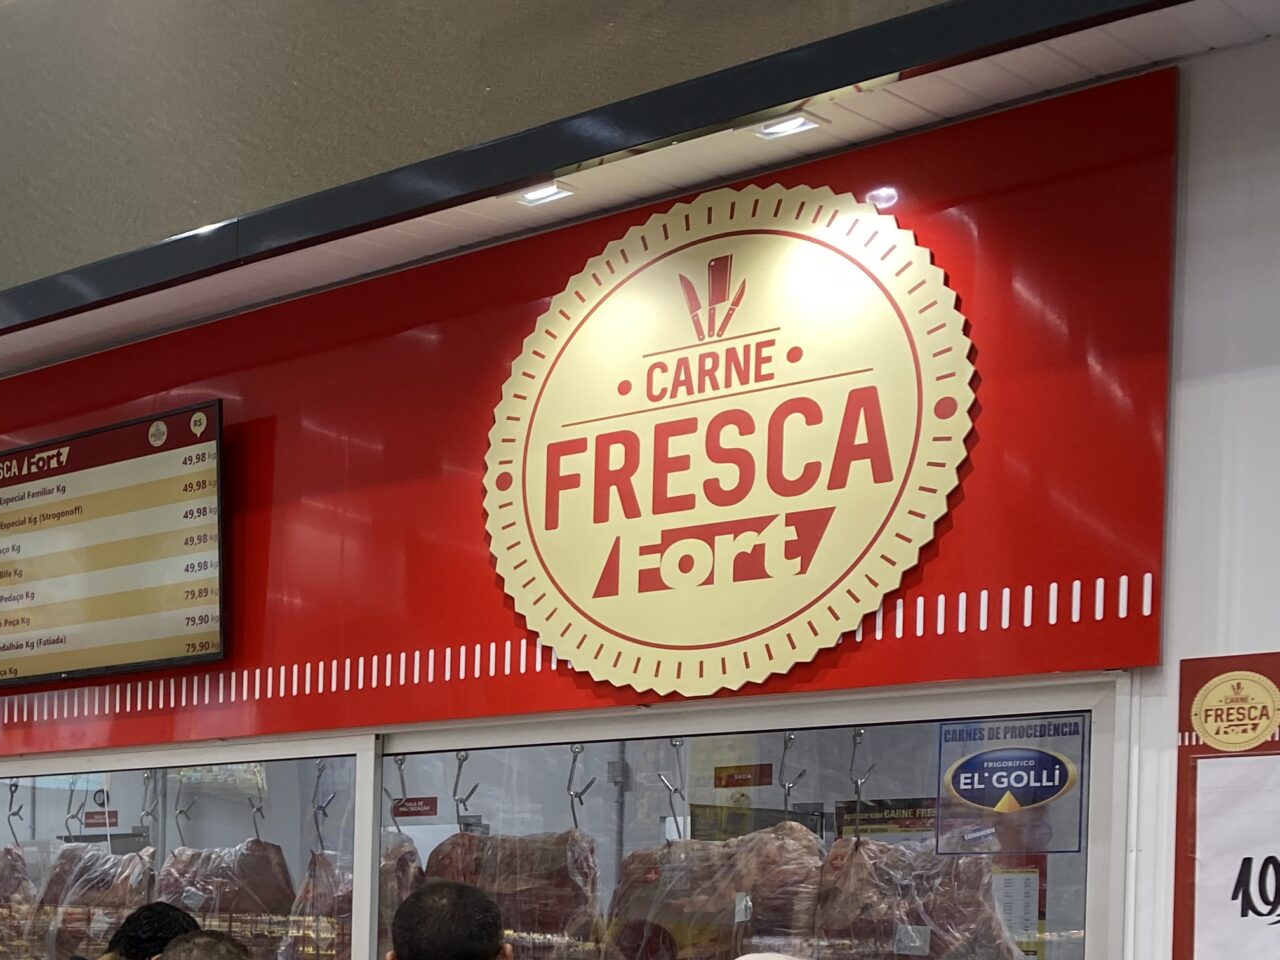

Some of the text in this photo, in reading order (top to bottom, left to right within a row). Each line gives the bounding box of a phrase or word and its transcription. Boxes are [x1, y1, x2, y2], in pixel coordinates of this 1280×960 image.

[646, 339, 776, 402] CARNE
[182, 452, 207, 465] 49,98
[544, 385, 894, 531] FRESCA
[183, 480, 207, 492] 49,98
[0, 492, 26, 506] Especial
[27, 487, 54, 499] Familiar
[56, 483, 66, 495] Kg
[0, 516, 26, 531] Especial
[28, 514, 38, 526] Kg
[39, 505, 83, 524] (Strogonoff)
[183, 506, 208, 519] 49,98
[184, 534, 208, 546] 49,98
[11, 543, 21, 554] Kg
[592, 506, 837, 599] Fort
[0, 568, 12, 579] Bife
[13, 567, 23, 578] Kg
[184, 561, 209, 573] 49,98
[0, 591, 24, 604] Pedaço
[25, 590, 35, 601] Kg
[185, 587, 209, 600] 79,89
[4, 617, 20, 628] Peça
[21, 616, 30, 626] Kg
[185, 614, 210, 627] 79,90
[25, 639, 35, 650] Kg
[36, 634, 67, 649] (Fatiada)
[186, 641, 210, 653] 79,90
[9, 666, 18, 676] Kg
[1204, 705, 1270, 723] FRESCA
[944, 721, 1080, 742] CARNES DE PROCEDÊNCIA
[883, 809, 914, 818] CARNE
